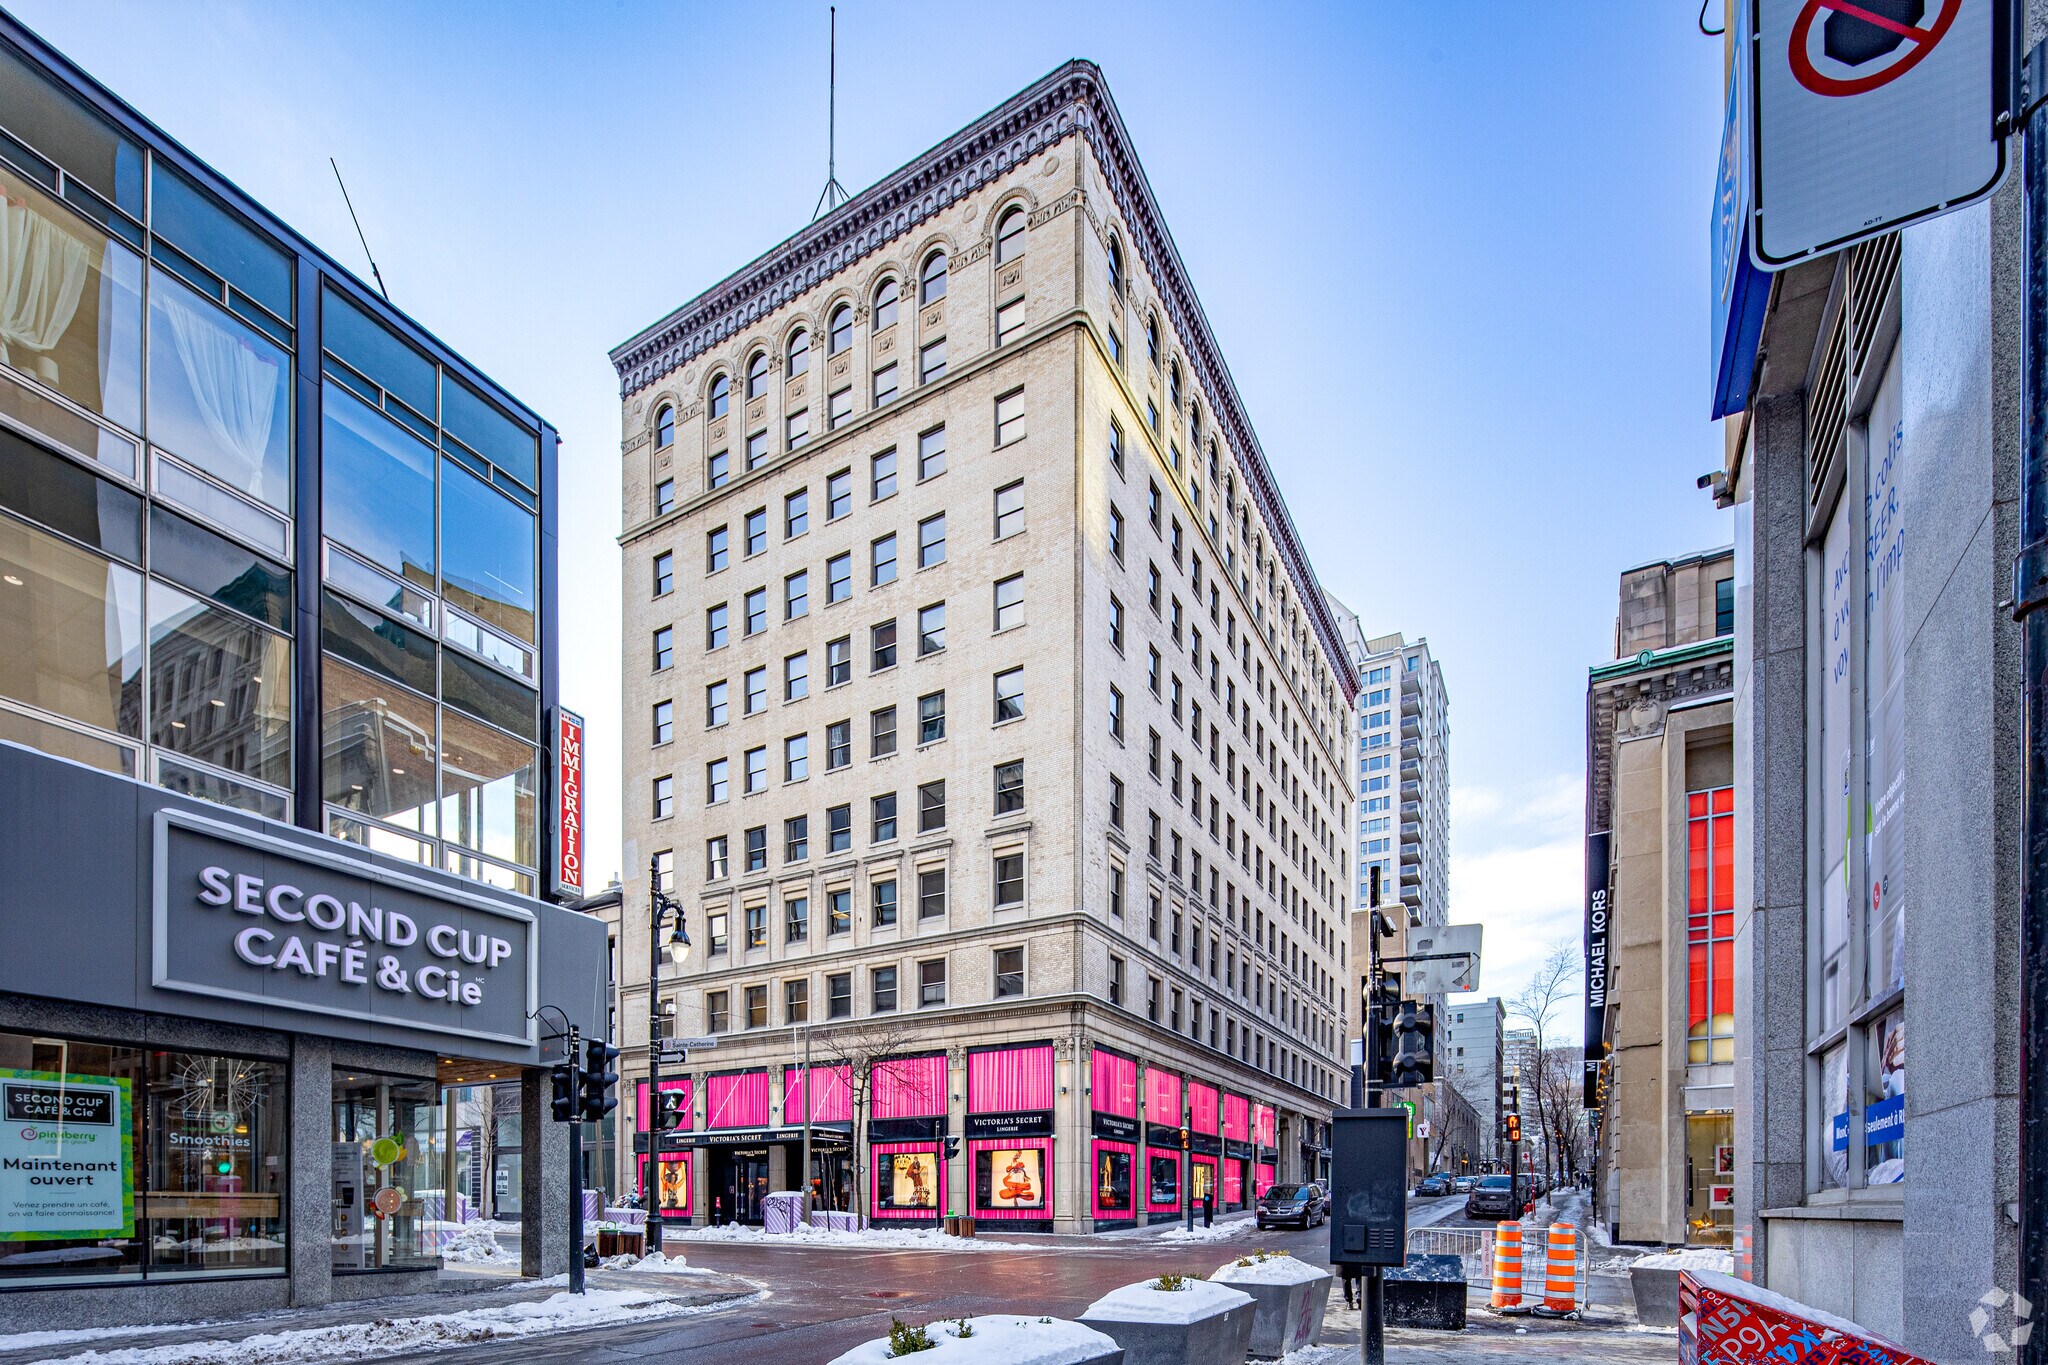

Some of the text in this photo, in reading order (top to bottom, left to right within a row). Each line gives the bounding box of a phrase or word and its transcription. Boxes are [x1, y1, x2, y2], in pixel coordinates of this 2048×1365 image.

[563, 724, 580, 886] IMMIGRATION
[197, 866, 512, 968] SECOND CUP
[1590, 889, 1606, 1007] MICHAEL KORS
[233, 927, 368, 984] CAFÉ
[375, 955, 413, 993] &
[414, 965, 483, 1006] Cie
[15, 1093, 104, 1107] SECOND CUP
[24, 1105, 94, 1117] CAFÉ & Cie
[974, 1116, 1042, 1126] VICTORIA'S SECRET
[169, 1132, 251, 1147] Smoothies
[709, 1135, 740, 1143] VICTORIA'S
[3, 1158, 117, 1171] Maintenant
[30, 1175, 94, 1186] ouvert
[42, 1201, 75, 1209] prendre
[57, 1209, 115, 1217] connaissance!
